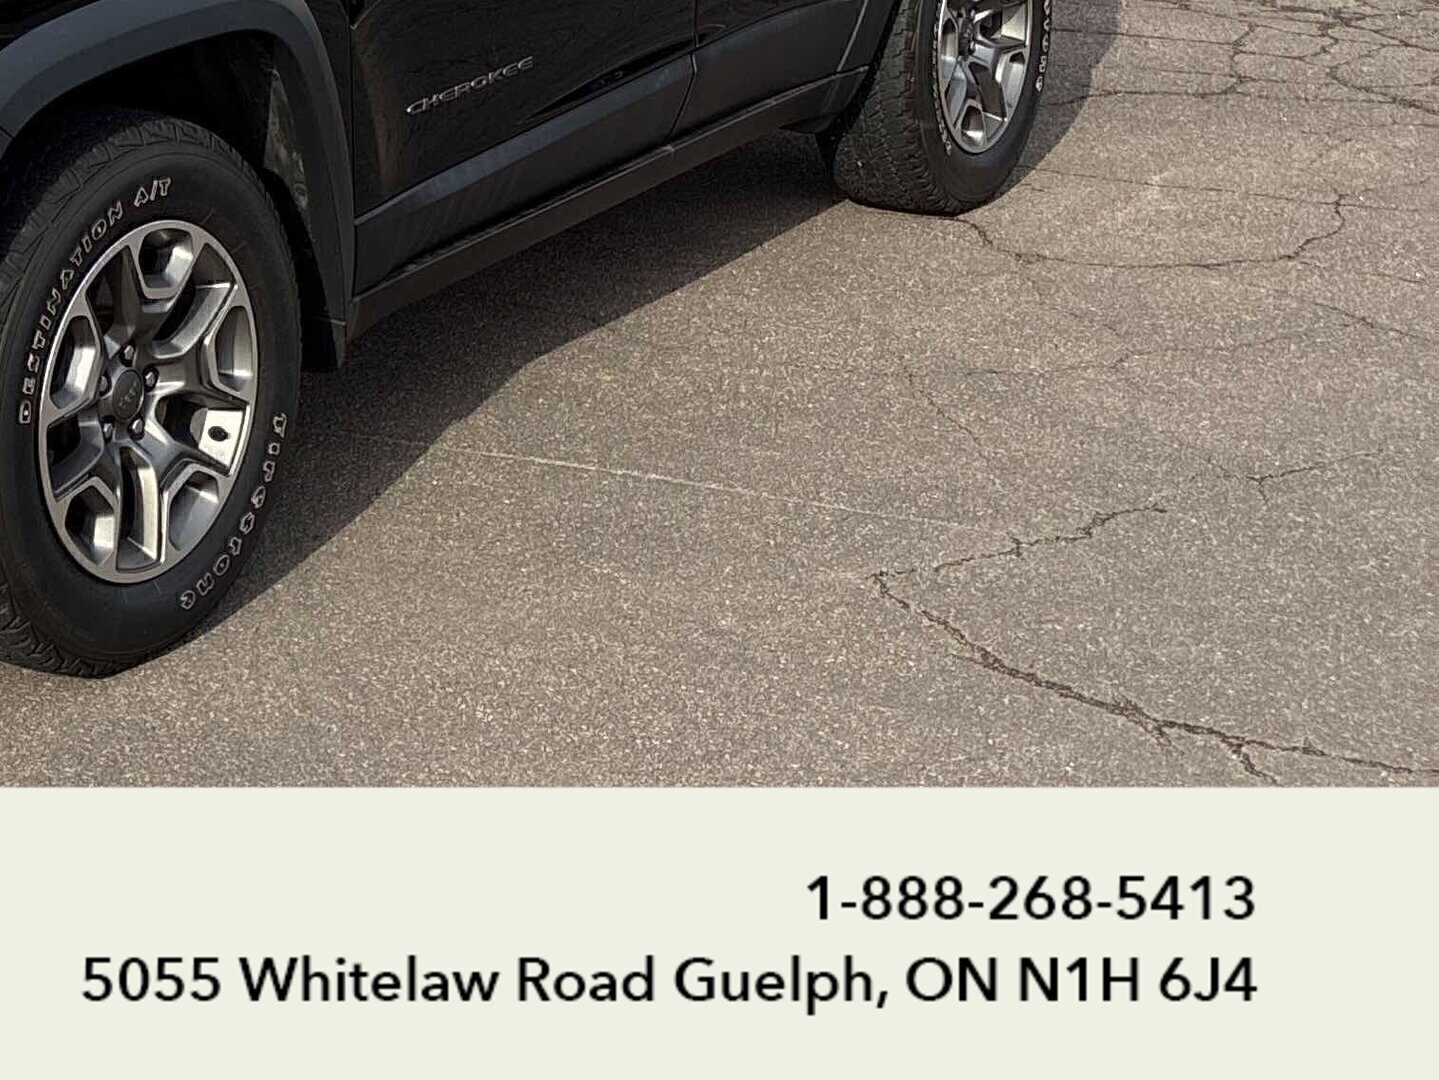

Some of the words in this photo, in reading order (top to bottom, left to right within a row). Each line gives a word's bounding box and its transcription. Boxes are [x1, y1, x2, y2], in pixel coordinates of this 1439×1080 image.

[406, 55, 534, 115] CHEROKEE
[17, 200, 124, 425] DESTINATION
[132, 176, 172, 207] A/T
